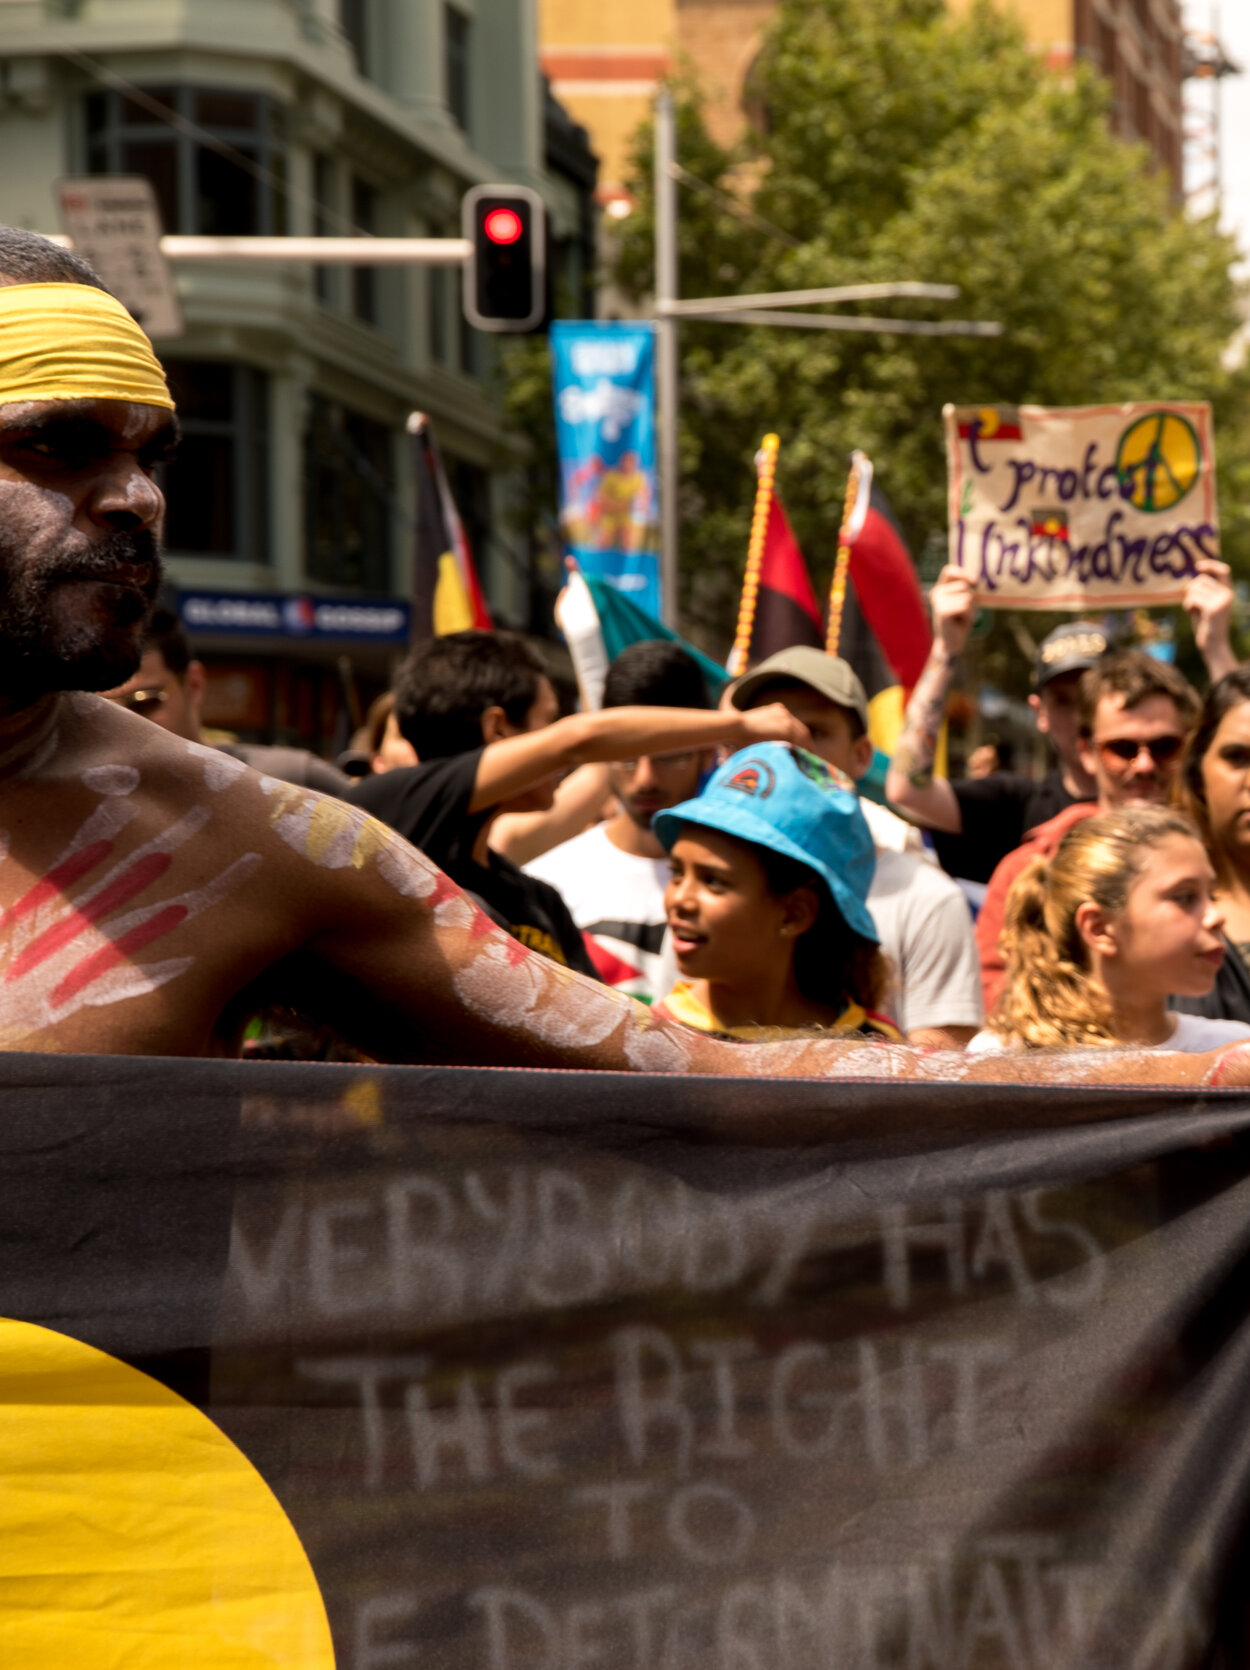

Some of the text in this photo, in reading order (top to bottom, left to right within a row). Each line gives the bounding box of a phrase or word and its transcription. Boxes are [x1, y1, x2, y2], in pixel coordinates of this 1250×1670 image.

[878, 1185, 1106, 1310] HAS
[297, 1324, 1018, 1490] THE RIGHT
[573, 1480, 757, 1565] TO
